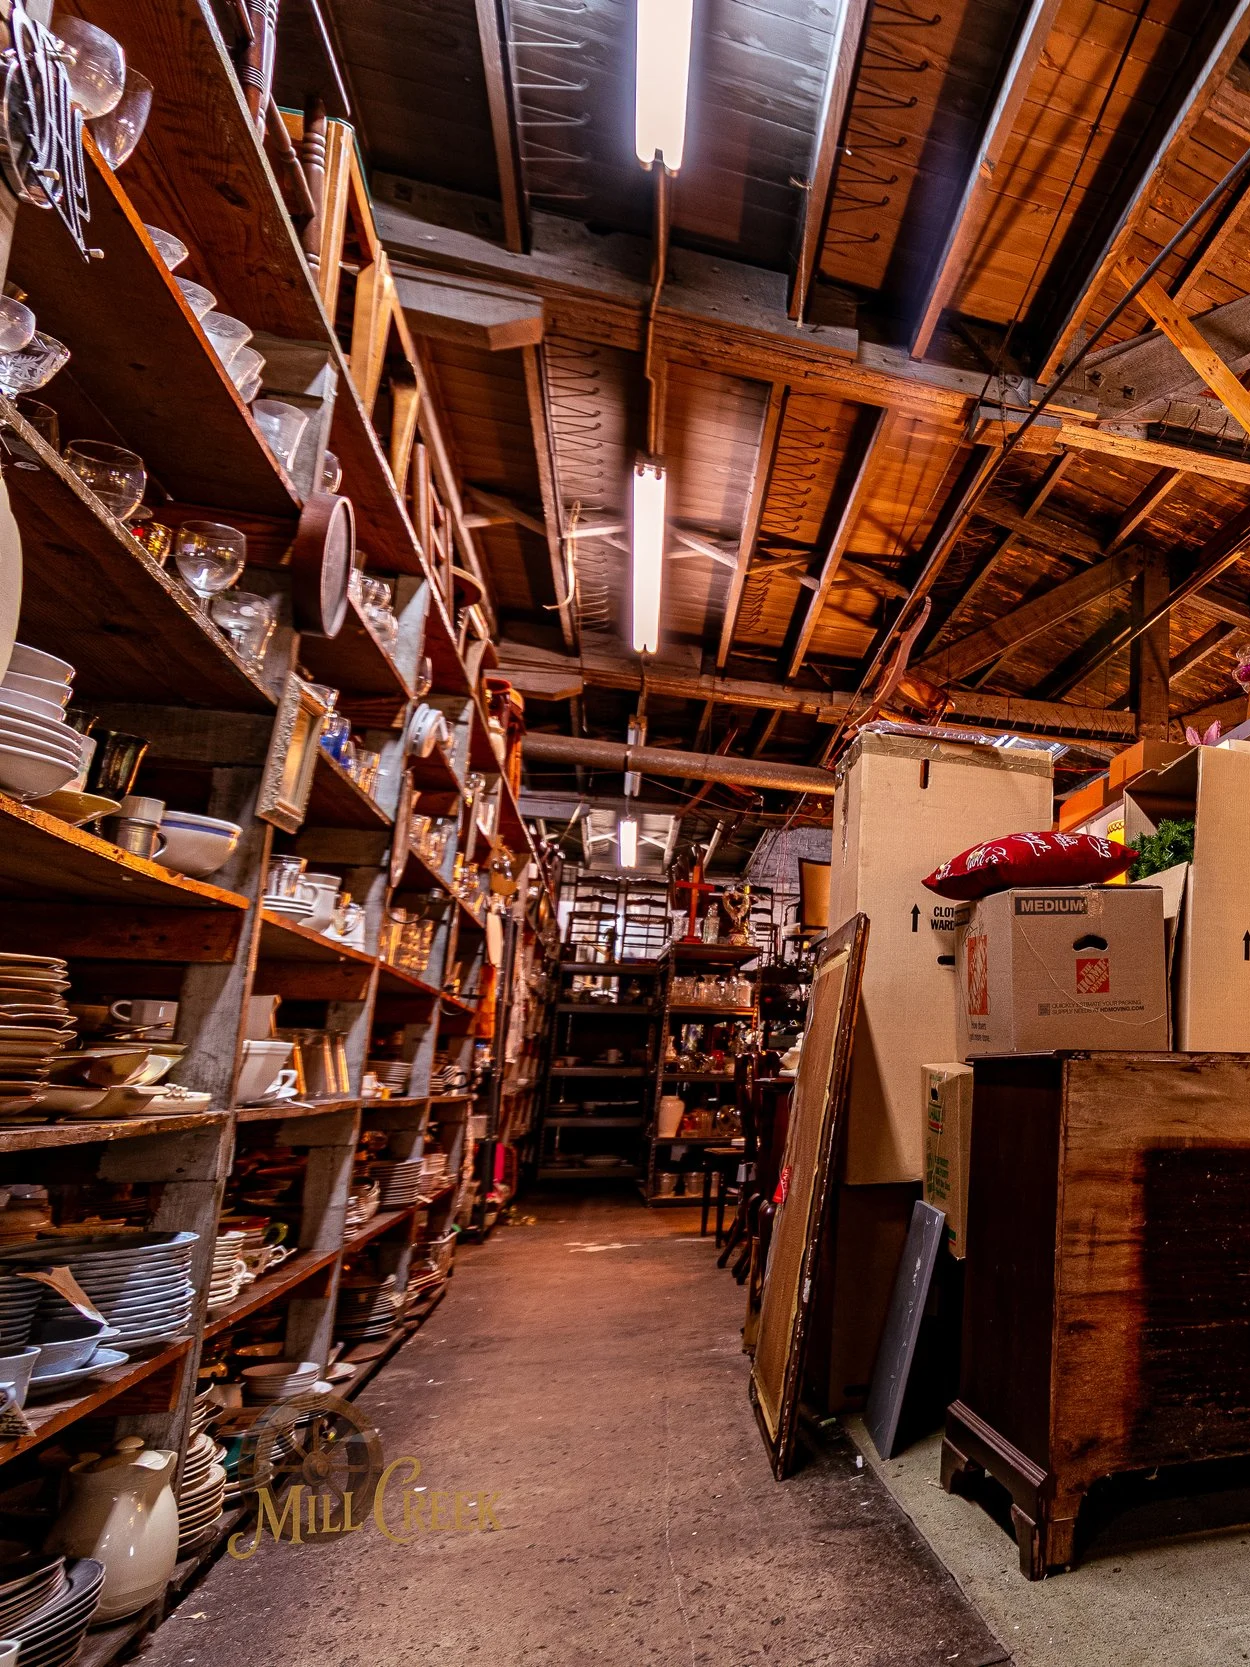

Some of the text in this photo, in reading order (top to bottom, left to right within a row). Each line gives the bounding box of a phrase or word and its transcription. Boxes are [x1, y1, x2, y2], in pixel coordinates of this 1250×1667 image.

[933, 906, 955, 918] CLOT
[1021, 900, 1083, 912] MEDIUM
[930, 919, 955, 931] WARD
[1077, 959, 1108, 993] HOME
[1090, 971, 1109, 993] DEPOT
[1100, 1005, 1145, 1013] HDMOVING.COM
